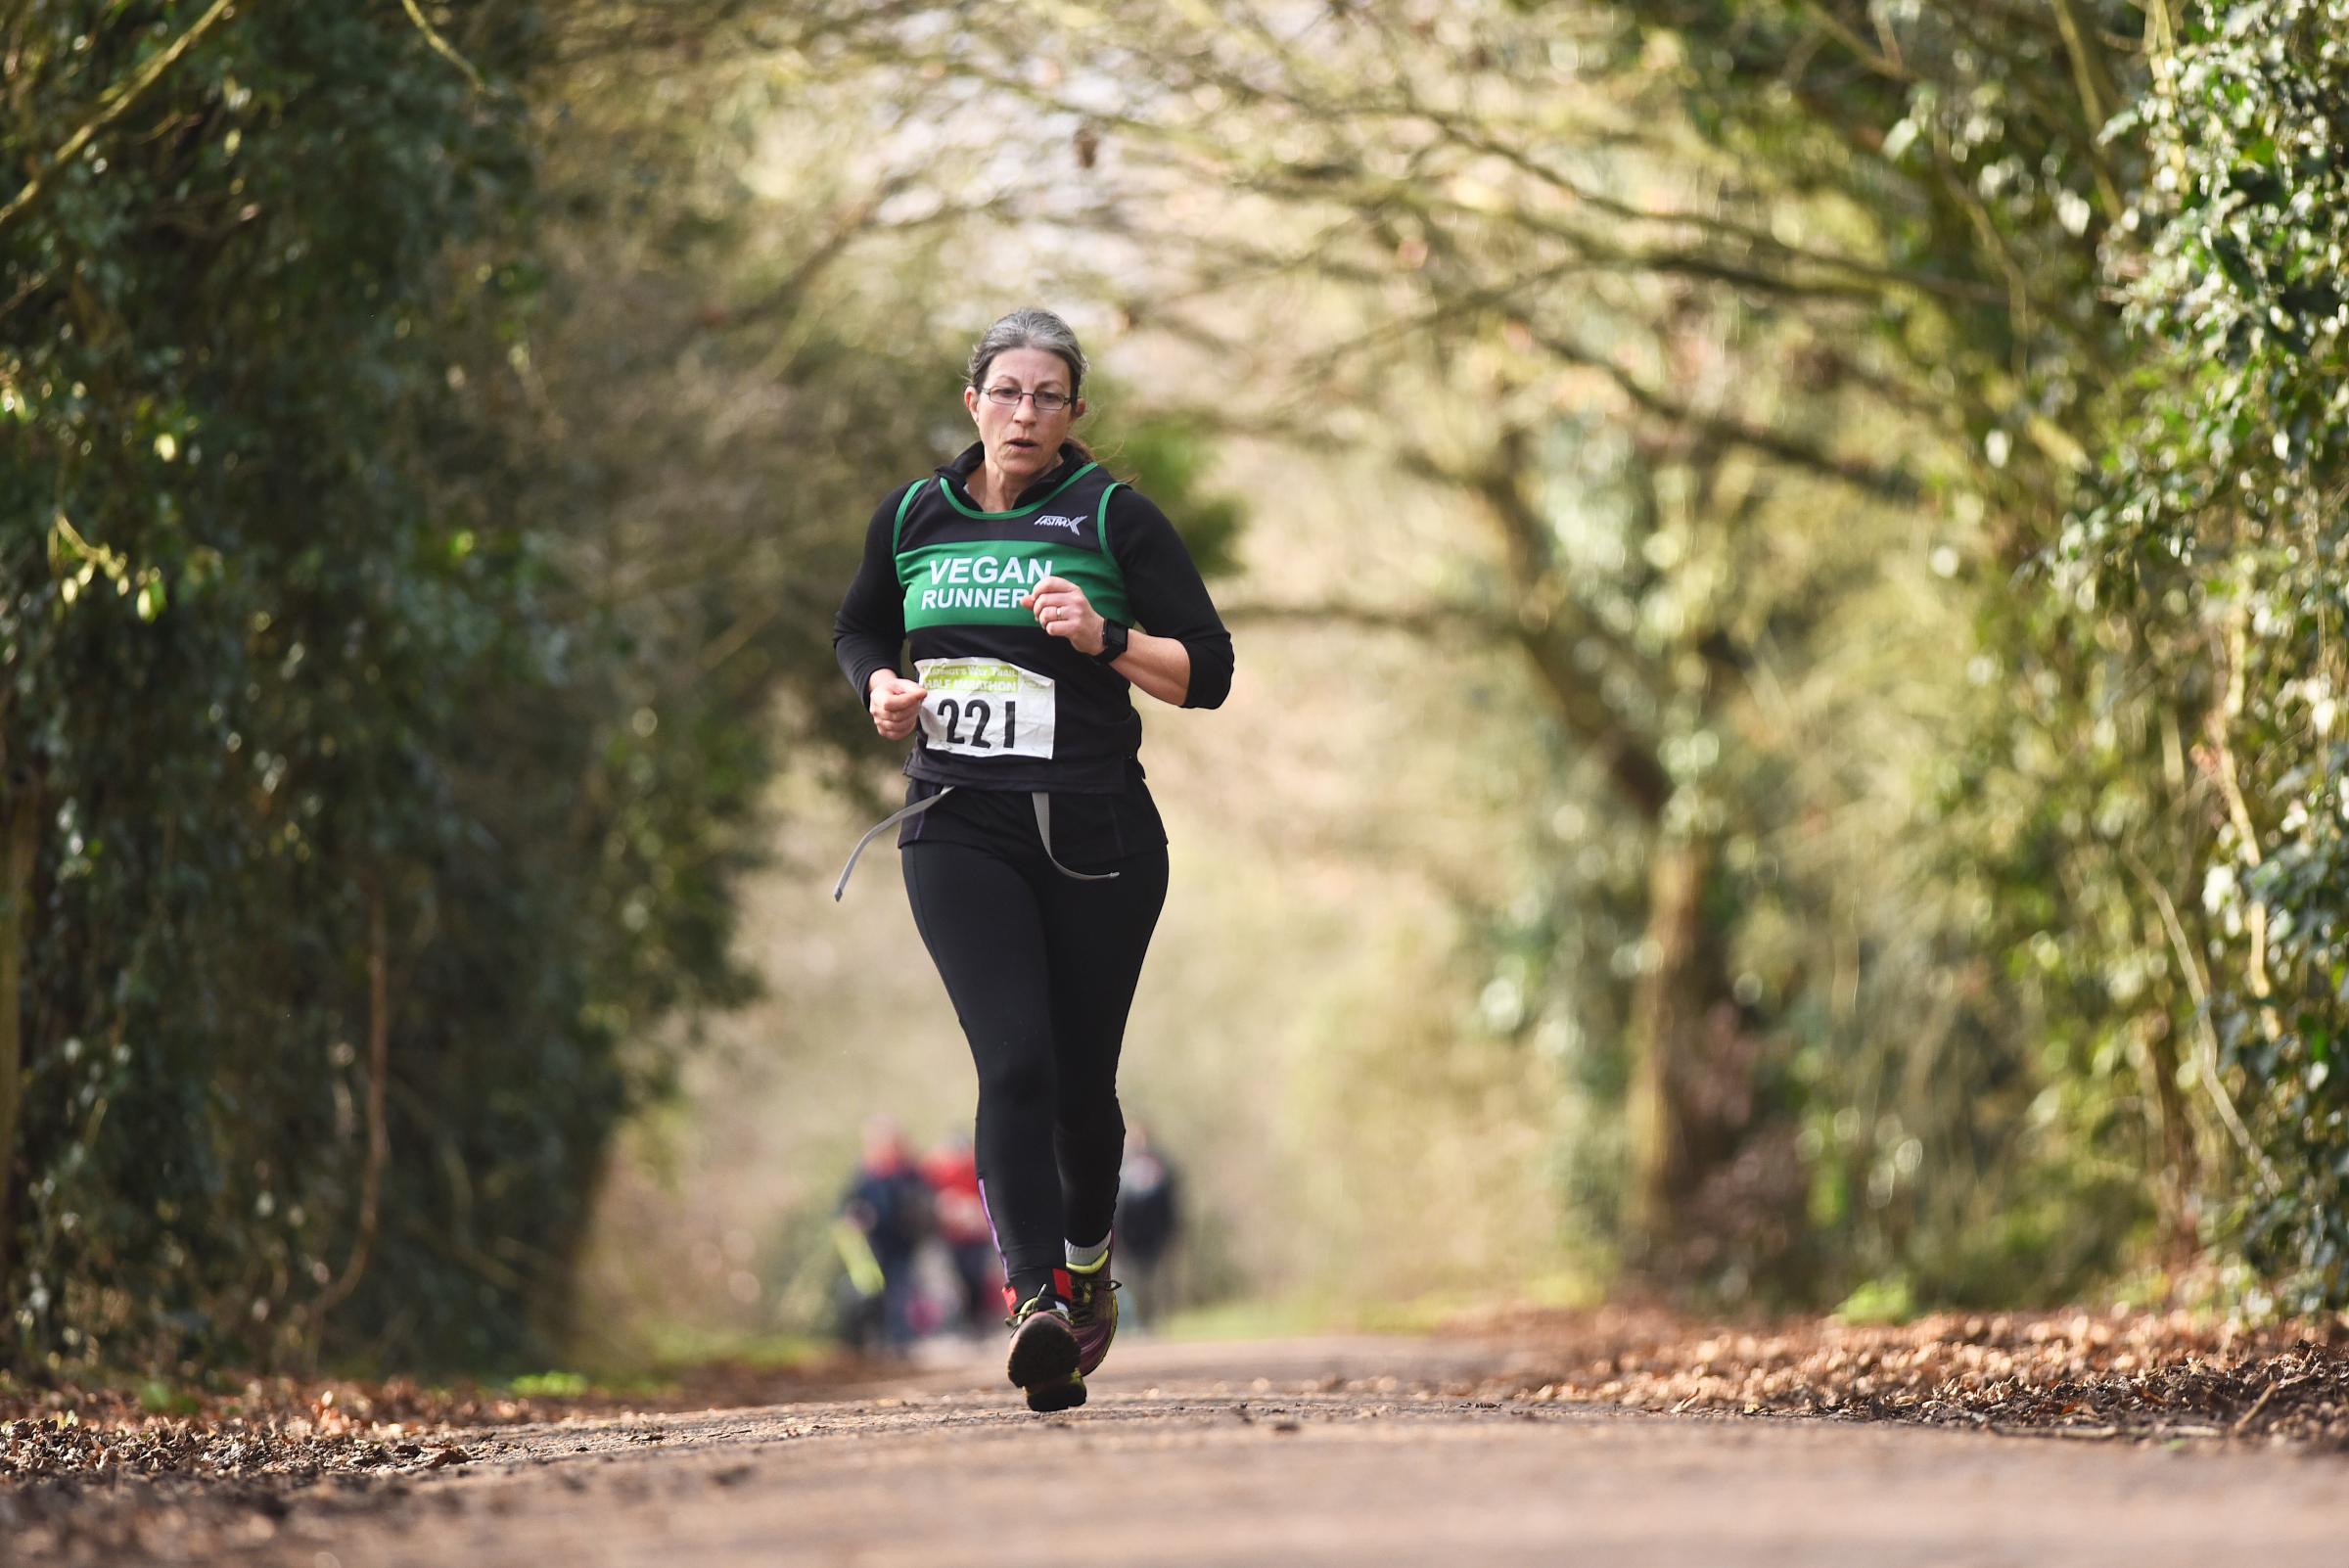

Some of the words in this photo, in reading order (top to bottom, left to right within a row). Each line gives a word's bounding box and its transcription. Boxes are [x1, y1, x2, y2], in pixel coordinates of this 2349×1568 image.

[929, 556, 1052, 585] VEGAN
[921, 587, 1030, 610] RUNNER
[937, 698, 1015, 749] 221
